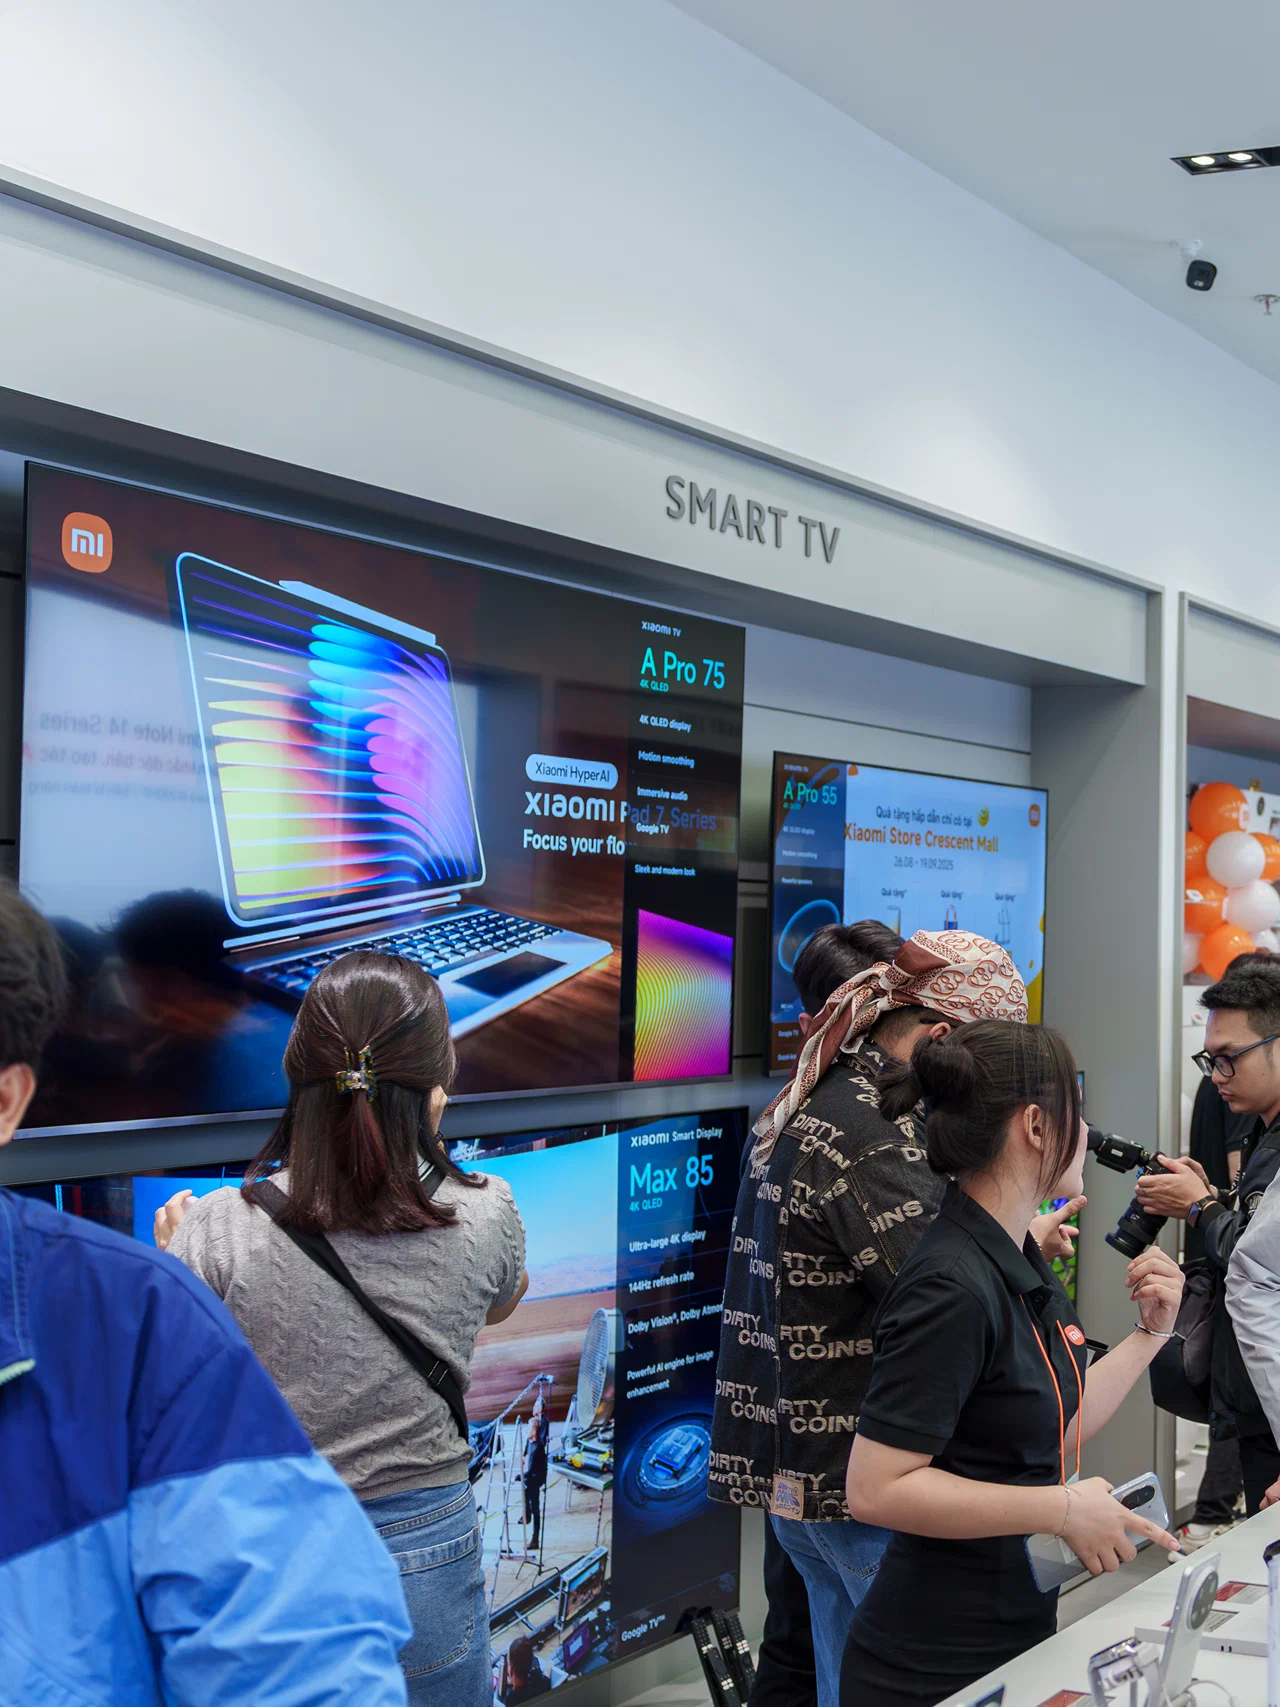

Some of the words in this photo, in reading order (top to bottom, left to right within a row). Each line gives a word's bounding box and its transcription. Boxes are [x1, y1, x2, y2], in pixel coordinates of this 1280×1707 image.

[666, 475, 788, 549] SMART
[798, 515, 841, 564] TV
[672, 628, 681, 637] TV
[640, 647, 657, 677] A
[663, 650, 697, 684] Pro
[702, 658, 726, 690] 75
[639, 679, 649, 689] 4K
[650, 680, 669, 692] QLED
[639, 714, 649, 725] 4K
[650, 716, 668, 728] QLED
[669, 719, 692, 734] display
[638, 750, 661, 763] Motion
[662, 756, 695, 769] smoothing
[535, 762, 568, 778] Xiaomi
[569, 768, 610, 784] HyperAI
[637, 786, 670, 800] Immersive
[671, 791, 688, 801] audio
[783, 781, 794, 800] A
[797, 782, 818, 803] Pro
[822, 785, 837, 805] 55
[620, 801, 650, 825] Pad
[655, 805, 665, 825] 7
[670, 806, 717, 831] Series
[876, 806, 892, 819] Quà
[636, 822, 659, 835] Google
[660, 825, 670, 835] TV
[843, 823, 886, 843] Xiaomi
[890, 827, 921, 846] Store
[925, 831, 973, 851] Crescent
[977, 836, 998, 852] Mall
[523, 828, 567, 850] Focus
[570, 836, 603, 856] your
[635, 864, 650, 874] Sleek
[652, 867, 662, 875] and
[663, 868, 683, 876] modern
[684, 867, 696, 876] look
[672, 1130, 694, 1142] Smart
[696, 1127, 723, 1140] Display
[791, 1113, 845, 1144] DIRTY
[799, 1135, 851, 1170] COIN
[630, 1162, 678, 1197] Max
[685, 1154, 714, 1188] 85
[629, 1201, 640, 1212] 4K
[642, 1197, 663, 1210] QLED
[629, 1236, 668, 1252] Ultra-large
[670, 1233, 680, 1245] 4K
[681, 1229, 706, 1244] display
[782, 1251, 826, 1271] RTY
[628, 1279, 652, 1294] 144Hz
[653, 1273, 679, 1289] refresh
[679, 1271, 695, 1283] rate
[788, 1269, 857, 1287] COIN
[628, 1321, 650, 1334] Dolby
[680, 1308, 701, 1322] Dolby
[723, 1309, 761, 1331] DIRTY
[738, 1329, 777, 1352] COINS
[780, 1325, 828, 1342] RTY
[789, 1338, 873, 1361] COINS
[627, 1364, 656, 1381] Powerful
[656, 1362, 664, 1373] AI
[664, 1357, 685, 1371] engine
[686, 1353, 695, 1364] for
[695, 1350, 714, 1363] image
[626, 1379, 670, 1399] enhancement
[715, 1379, 758, 1402] DIRTY
[731, 1401, 778, 1425] COINS
[778, 1398, 830, 1416] IRTY
[789, 1415, 860, 1434] COIN
[709, 1450, 755, 1474] DIRTY
[621, 1624, 648, 1642] Google
